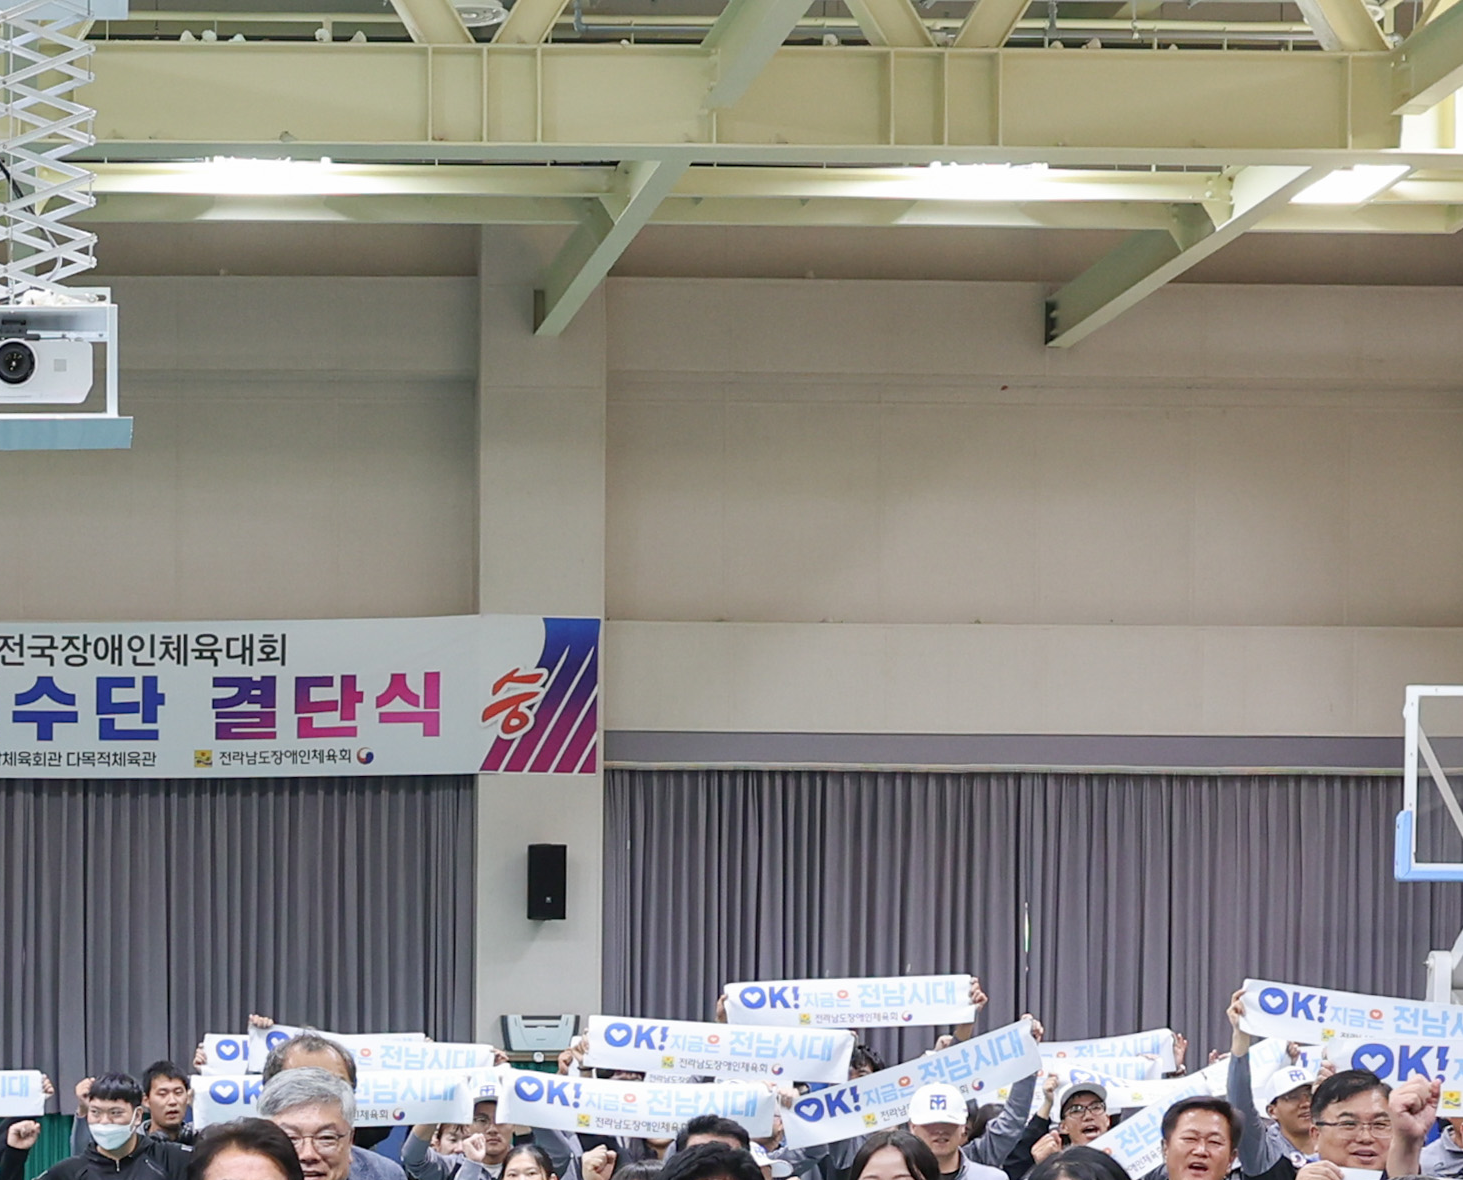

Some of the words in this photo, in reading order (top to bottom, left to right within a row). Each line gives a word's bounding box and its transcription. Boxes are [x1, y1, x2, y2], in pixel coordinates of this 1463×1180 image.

[211, 671, 442, 741] 결단식
[482, 668, 546, 735] 승
[66, 750, 157, 768] 다목적체육관
[219, 747, 353, 766] 전라남도장애인체육회
[739, 985, 800, 1010] OK!
[804, 989, 851, 1009] 지금은
[858, 980, 956, 1007] 전남시대
[1258, 986, 1328, 1023] OK!
[1329, 1007, 1385, 1029] 지금은
[604, 1022, 669, 1051] OK!
[671, 1033, 722, 1055] 지금은
[728, 1030, 834, 1062] 전남시대
[1351, 1042, 1449, 1083] OK!
[209, 1080, 263, 1105] OK
[793, 1083, 862, 1122] OK!
[864, 1075, 916, 1107] 지금은
[917, 1028, 1025, 1086] 전남시대
[514, 1075, 582, 1109] OK!
[585, 1092, 637, 1112] 지금은
[646, 1088, 759, 1118] 전남시대
